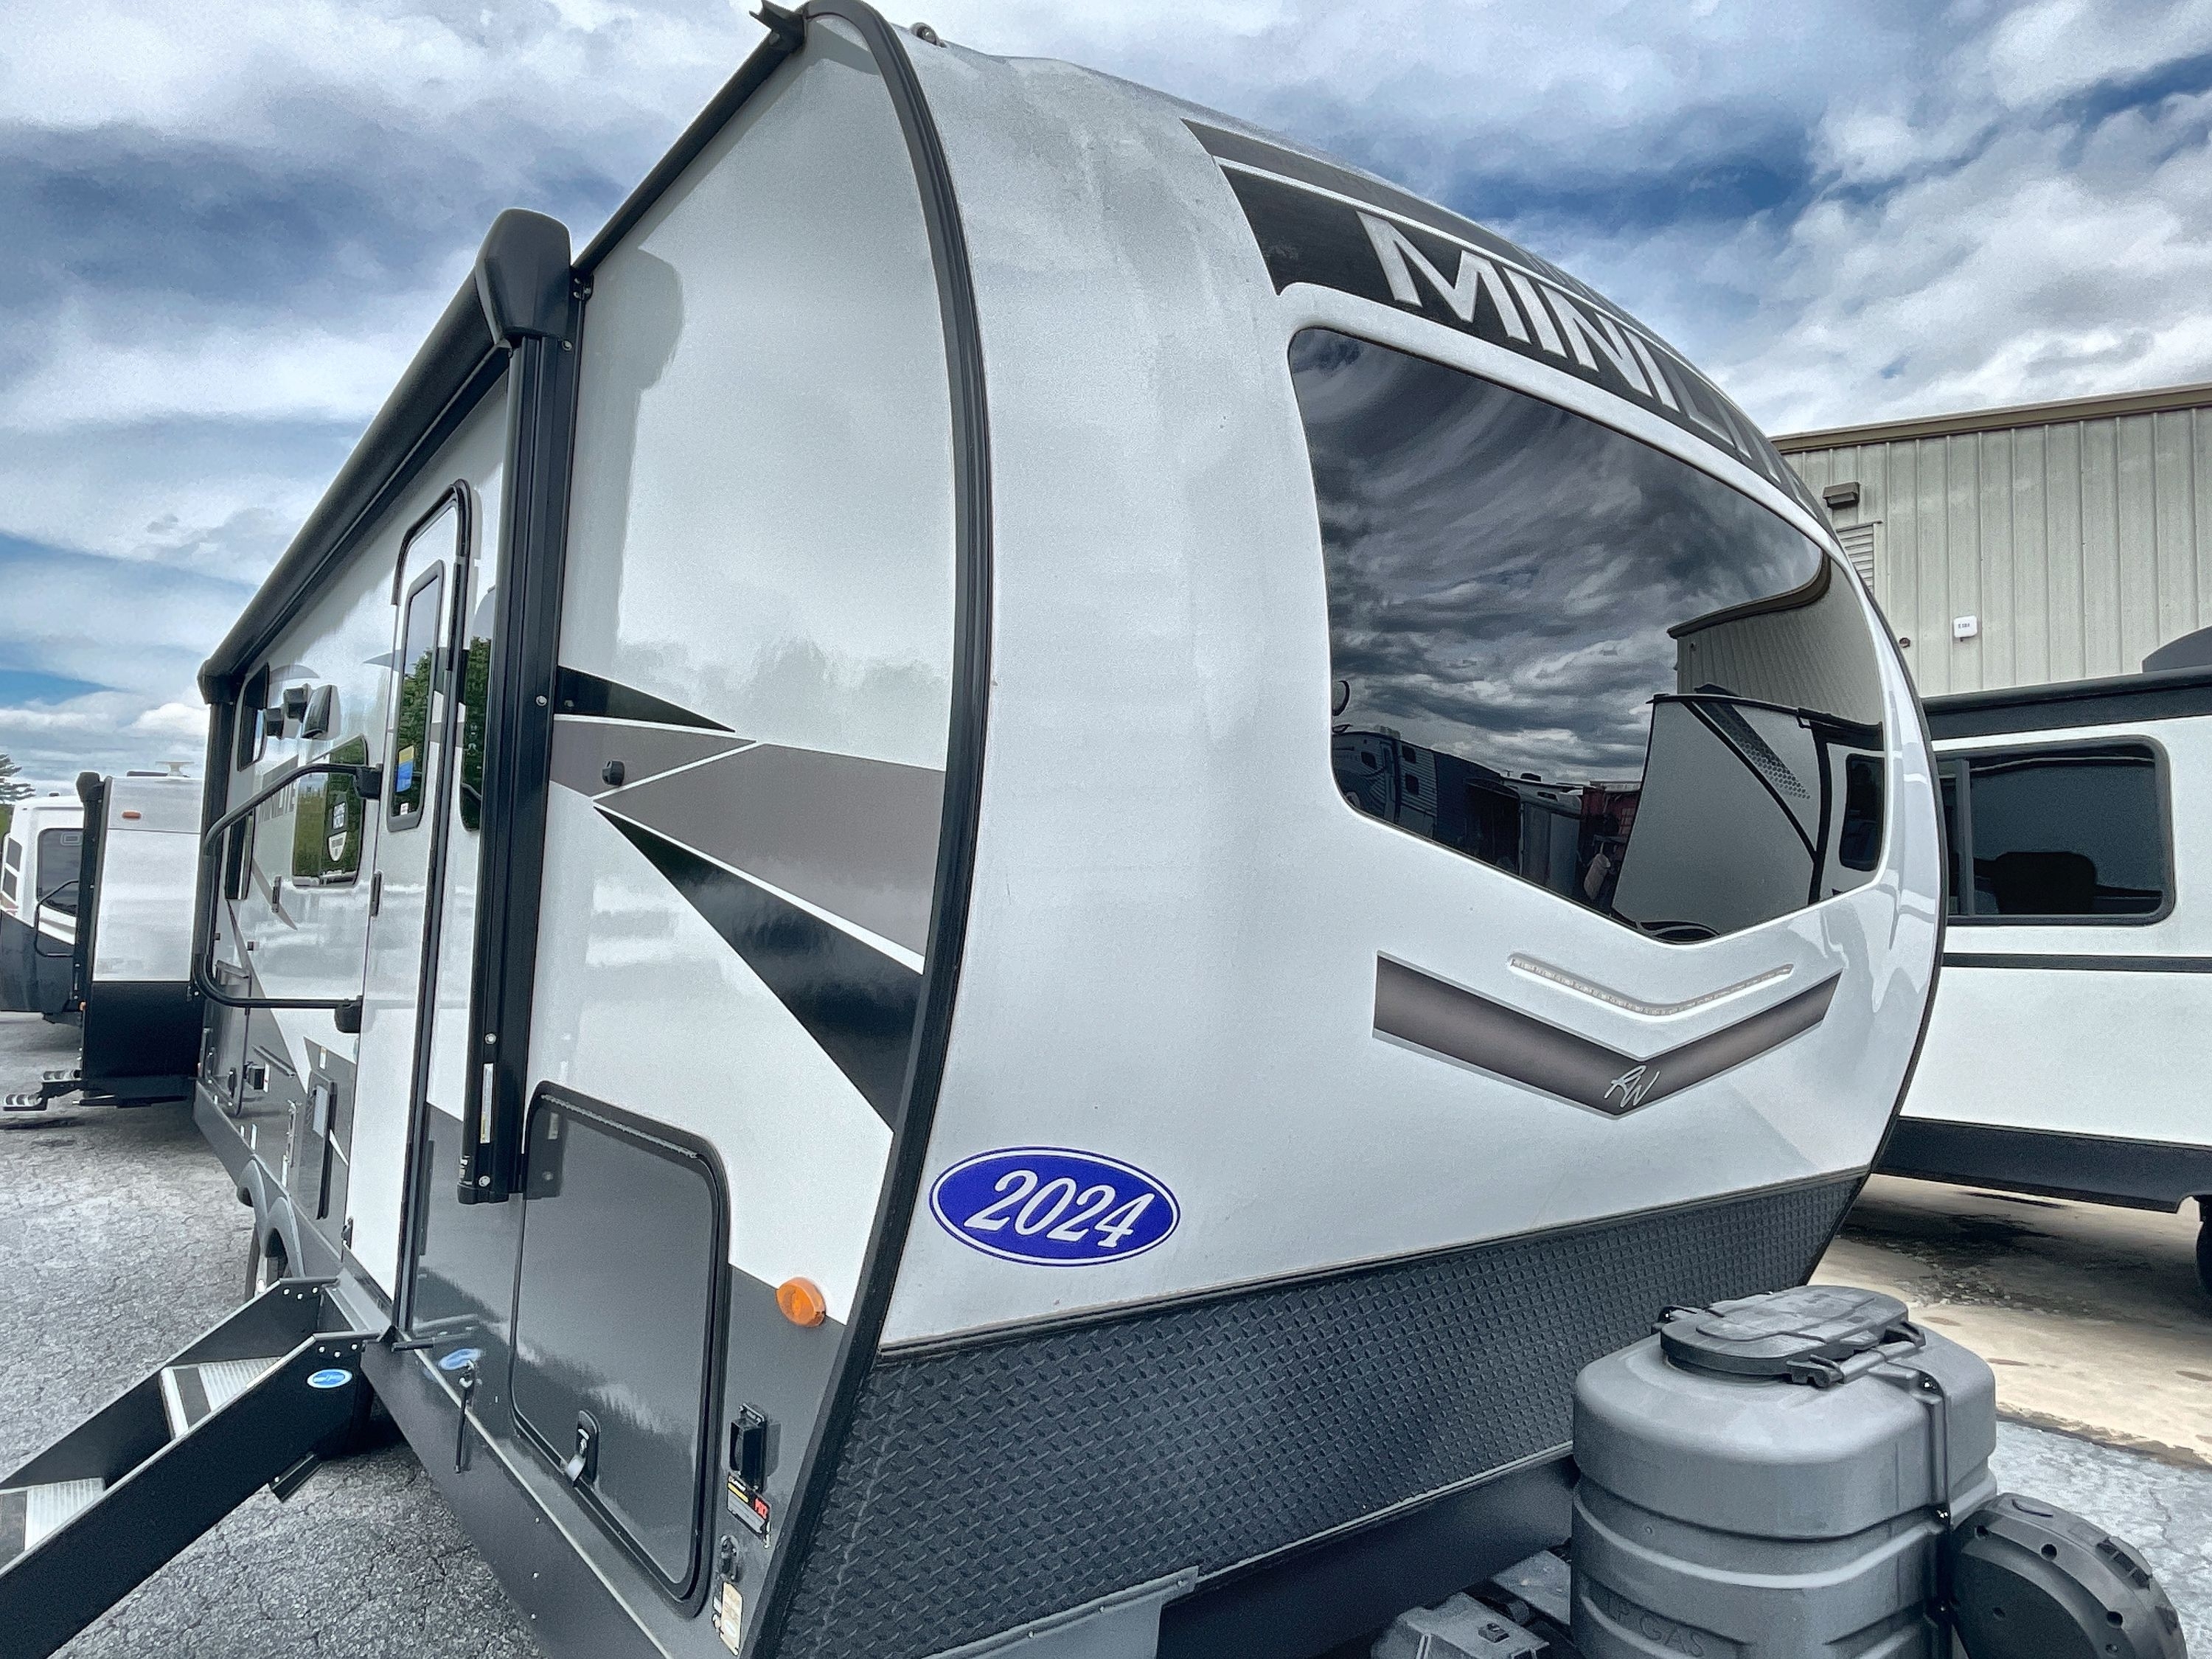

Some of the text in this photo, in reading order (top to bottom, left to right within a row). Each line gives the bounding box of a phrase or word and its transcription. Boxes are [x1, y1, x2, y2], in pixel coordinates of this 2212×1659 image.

[1355, 210, 1680, 412] MINI
[963, 1169, 1155, 1248] 2024
[1639, 1610, 1704, 1658] GAS
